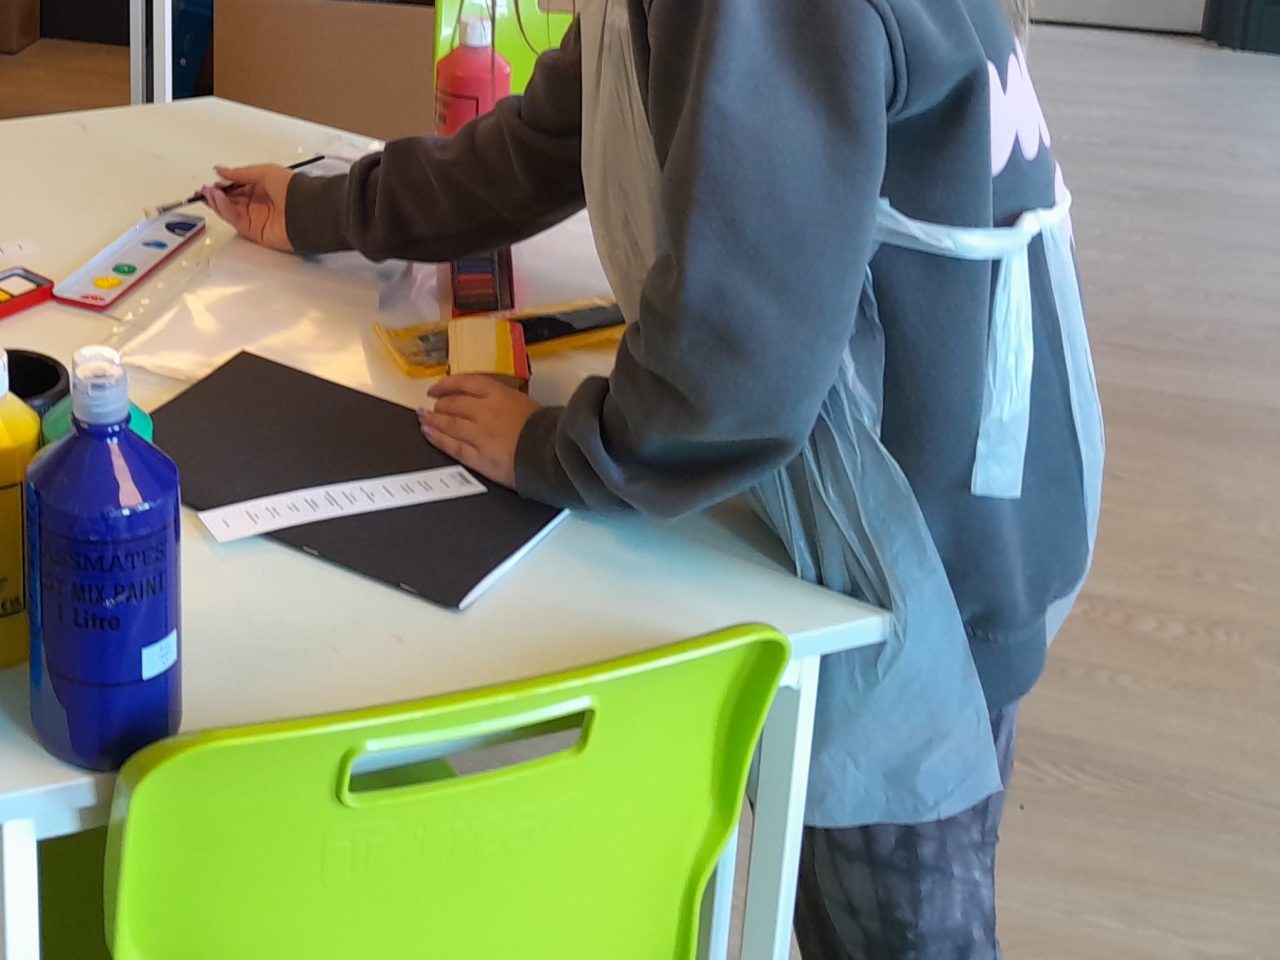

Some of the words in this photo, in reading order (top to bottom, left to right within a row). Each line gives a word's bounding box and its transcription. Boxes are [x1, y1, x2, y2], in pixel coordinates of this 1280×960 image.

[71, 581, 105, 606] MIX
[113, 570, 167, 606] PAINT
[73, 607, 121, 631] Litre
